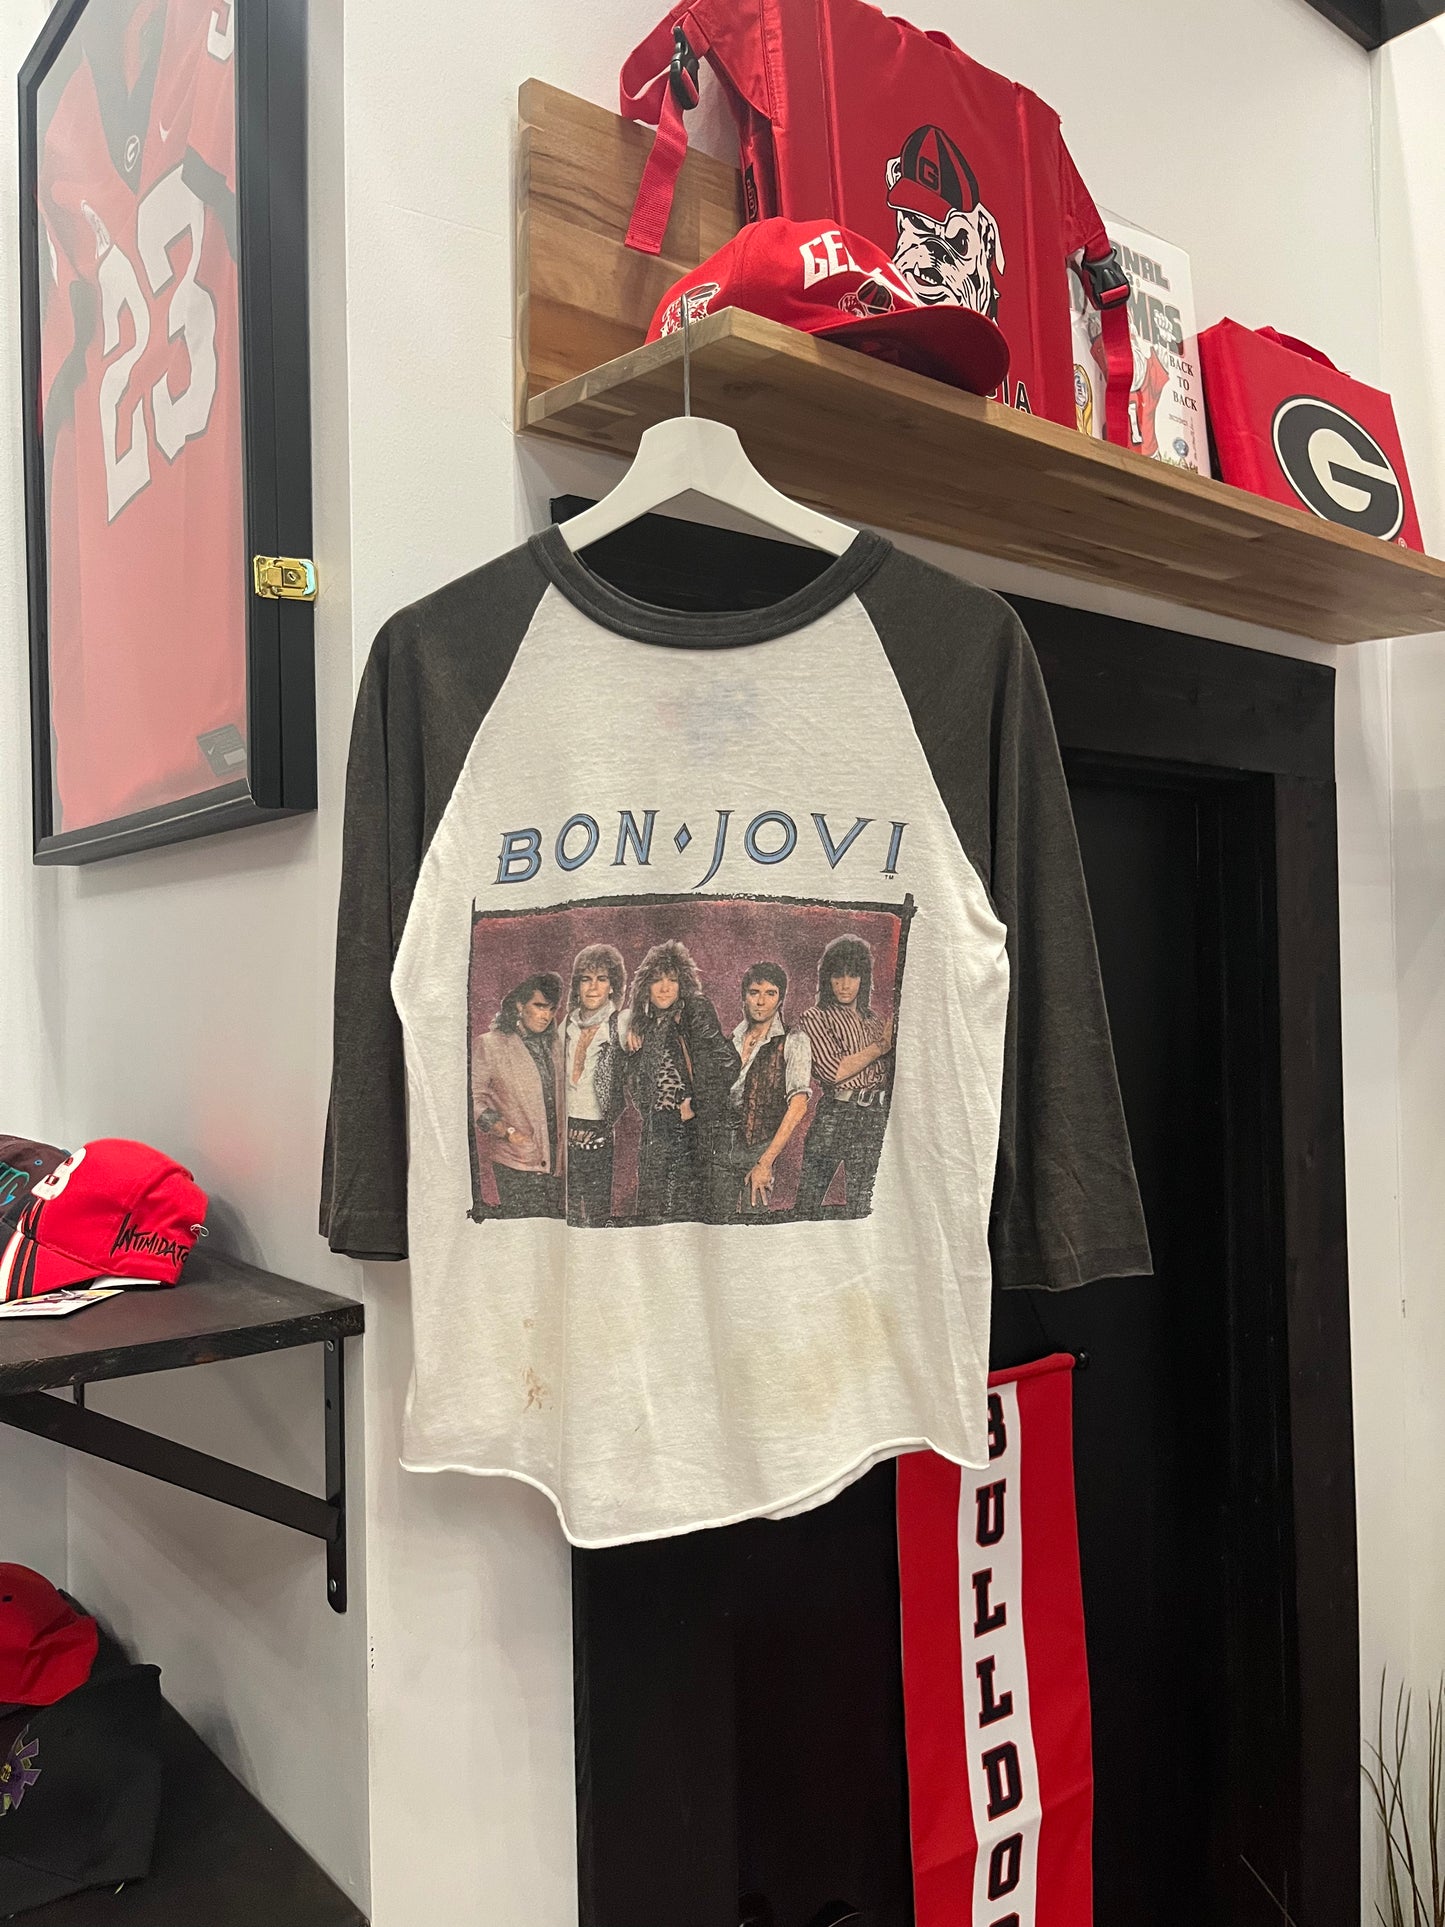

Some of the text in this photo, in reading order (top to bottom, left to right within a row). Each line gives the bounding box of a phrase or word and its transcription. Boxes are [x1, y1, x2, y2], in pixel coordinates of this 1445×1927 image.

[919, 156, 940, 191] G
[99, 164, 216, 526] 23
[1169, 354, 1194, 377] BACK
[985, 373, 1032, 415] IA
[1173, 391, 1198, 412] BACK
[1177, 375, 1190, 391] TO
[1271, 394, 1404, 541] G
[491, 809, 910, 890] BON JOVI
[972, 1391, 1024, 1927] BULLDO
